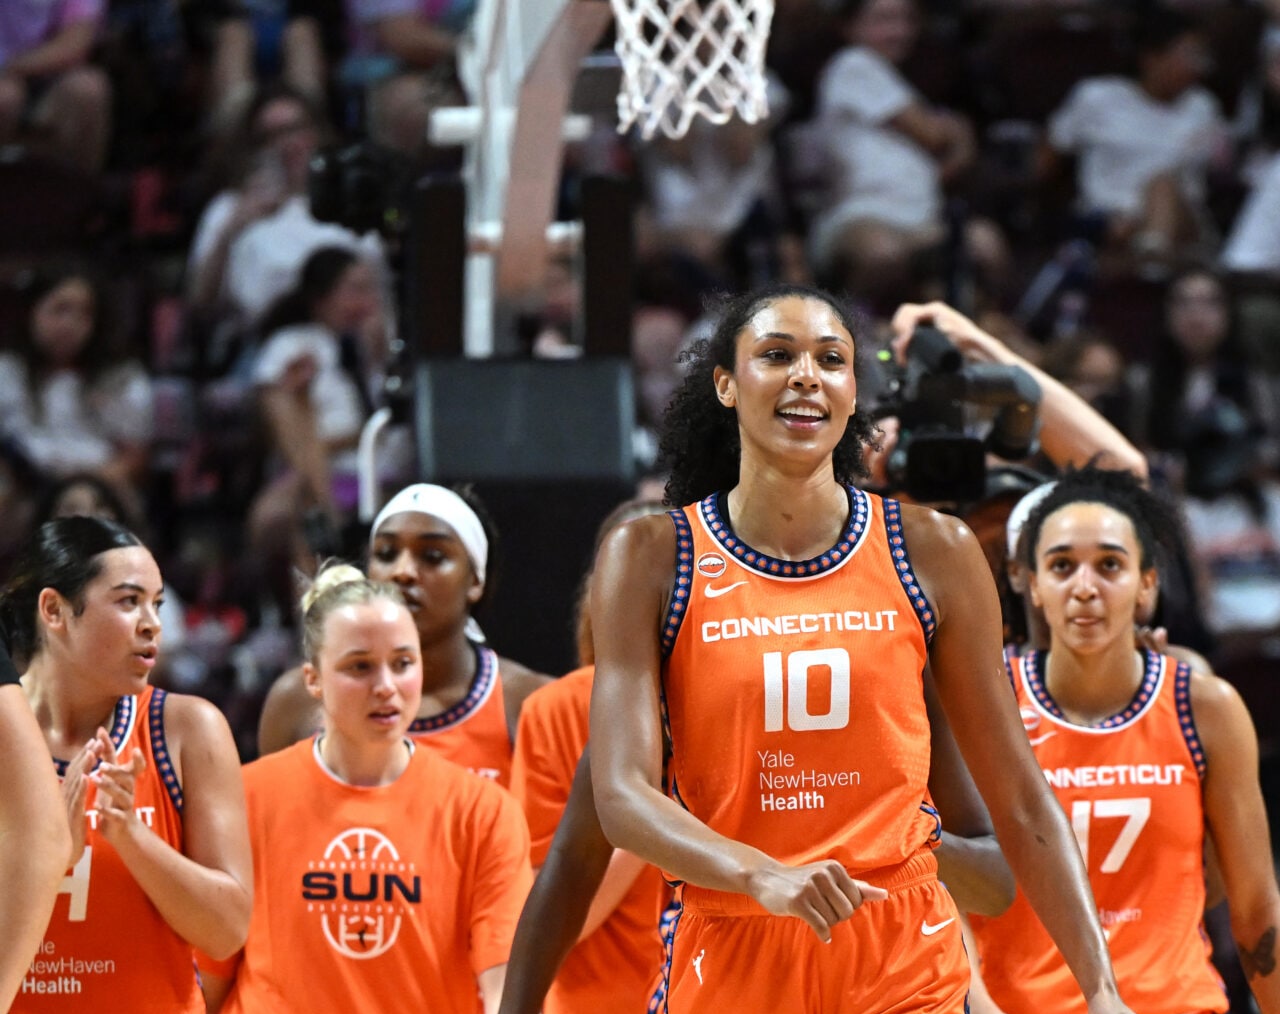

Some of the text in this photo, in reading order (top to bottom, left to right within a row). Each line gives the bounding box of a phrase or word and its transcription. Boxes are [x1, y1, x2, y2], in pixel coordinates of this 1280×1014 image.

[702, 611, 898, 643] CONNECTICUT
[763, 648, 850, 732] 10
[757, 750, 795, 768] Yale
[760, 769, 861, 789] NewHaven
[1043, 764, 1185, 788] NNECTICUT
[761, 791, 825, 812] Health
[1071, 797, 1151, 874] 17
[302, 872, 422, 904] SUN
[21, 977, 82, 994] Health
